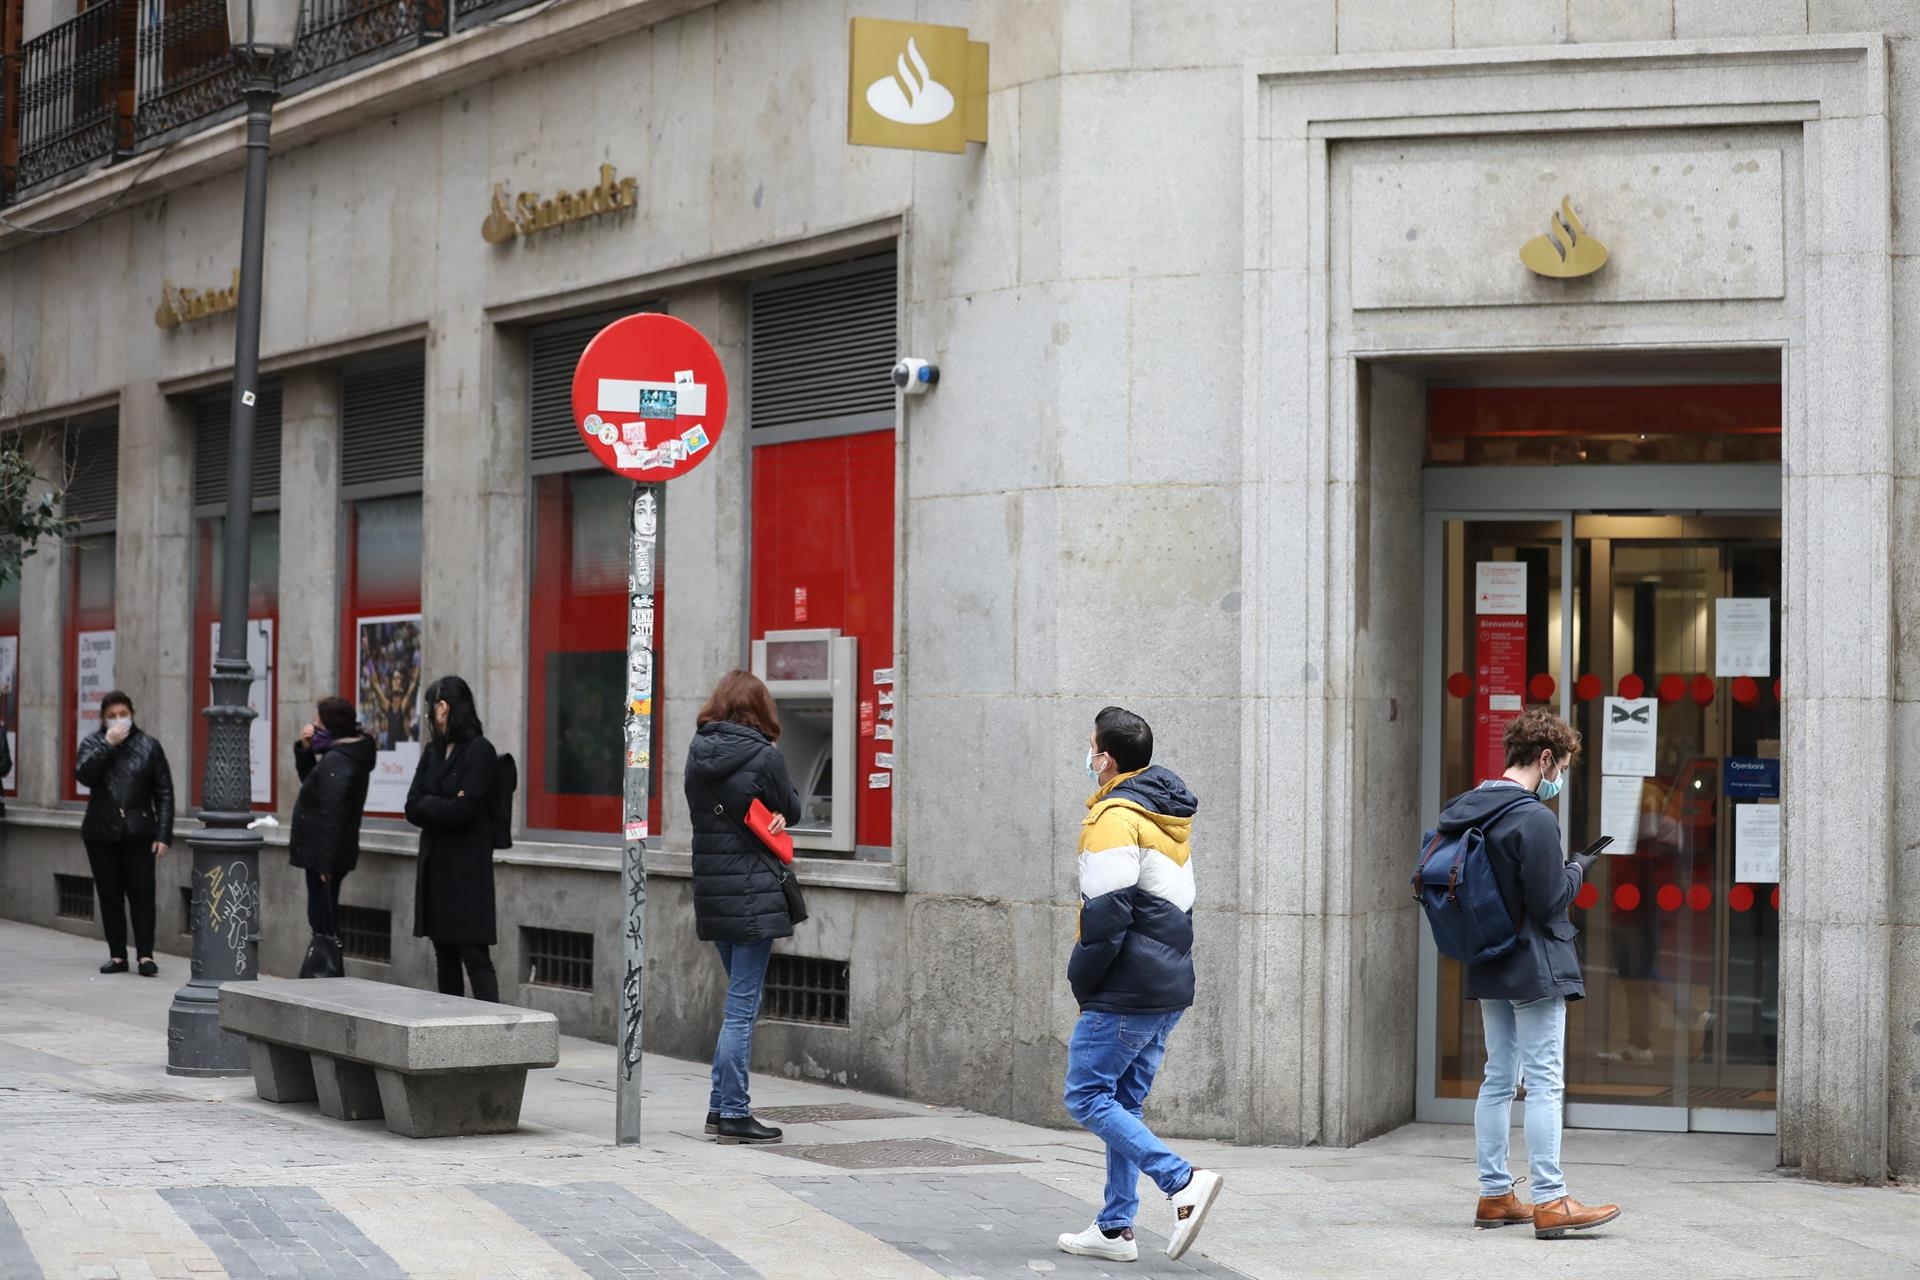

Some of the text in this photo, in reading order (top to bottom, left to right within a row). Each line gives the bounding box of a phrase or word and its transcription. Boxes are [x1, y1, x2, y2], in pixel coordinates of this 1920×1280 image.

[516, 163, 637, 235] Santander
[1480, 619, 1524, 629] Bienvenido
[1730, 761, 1766, 772] Openbank
